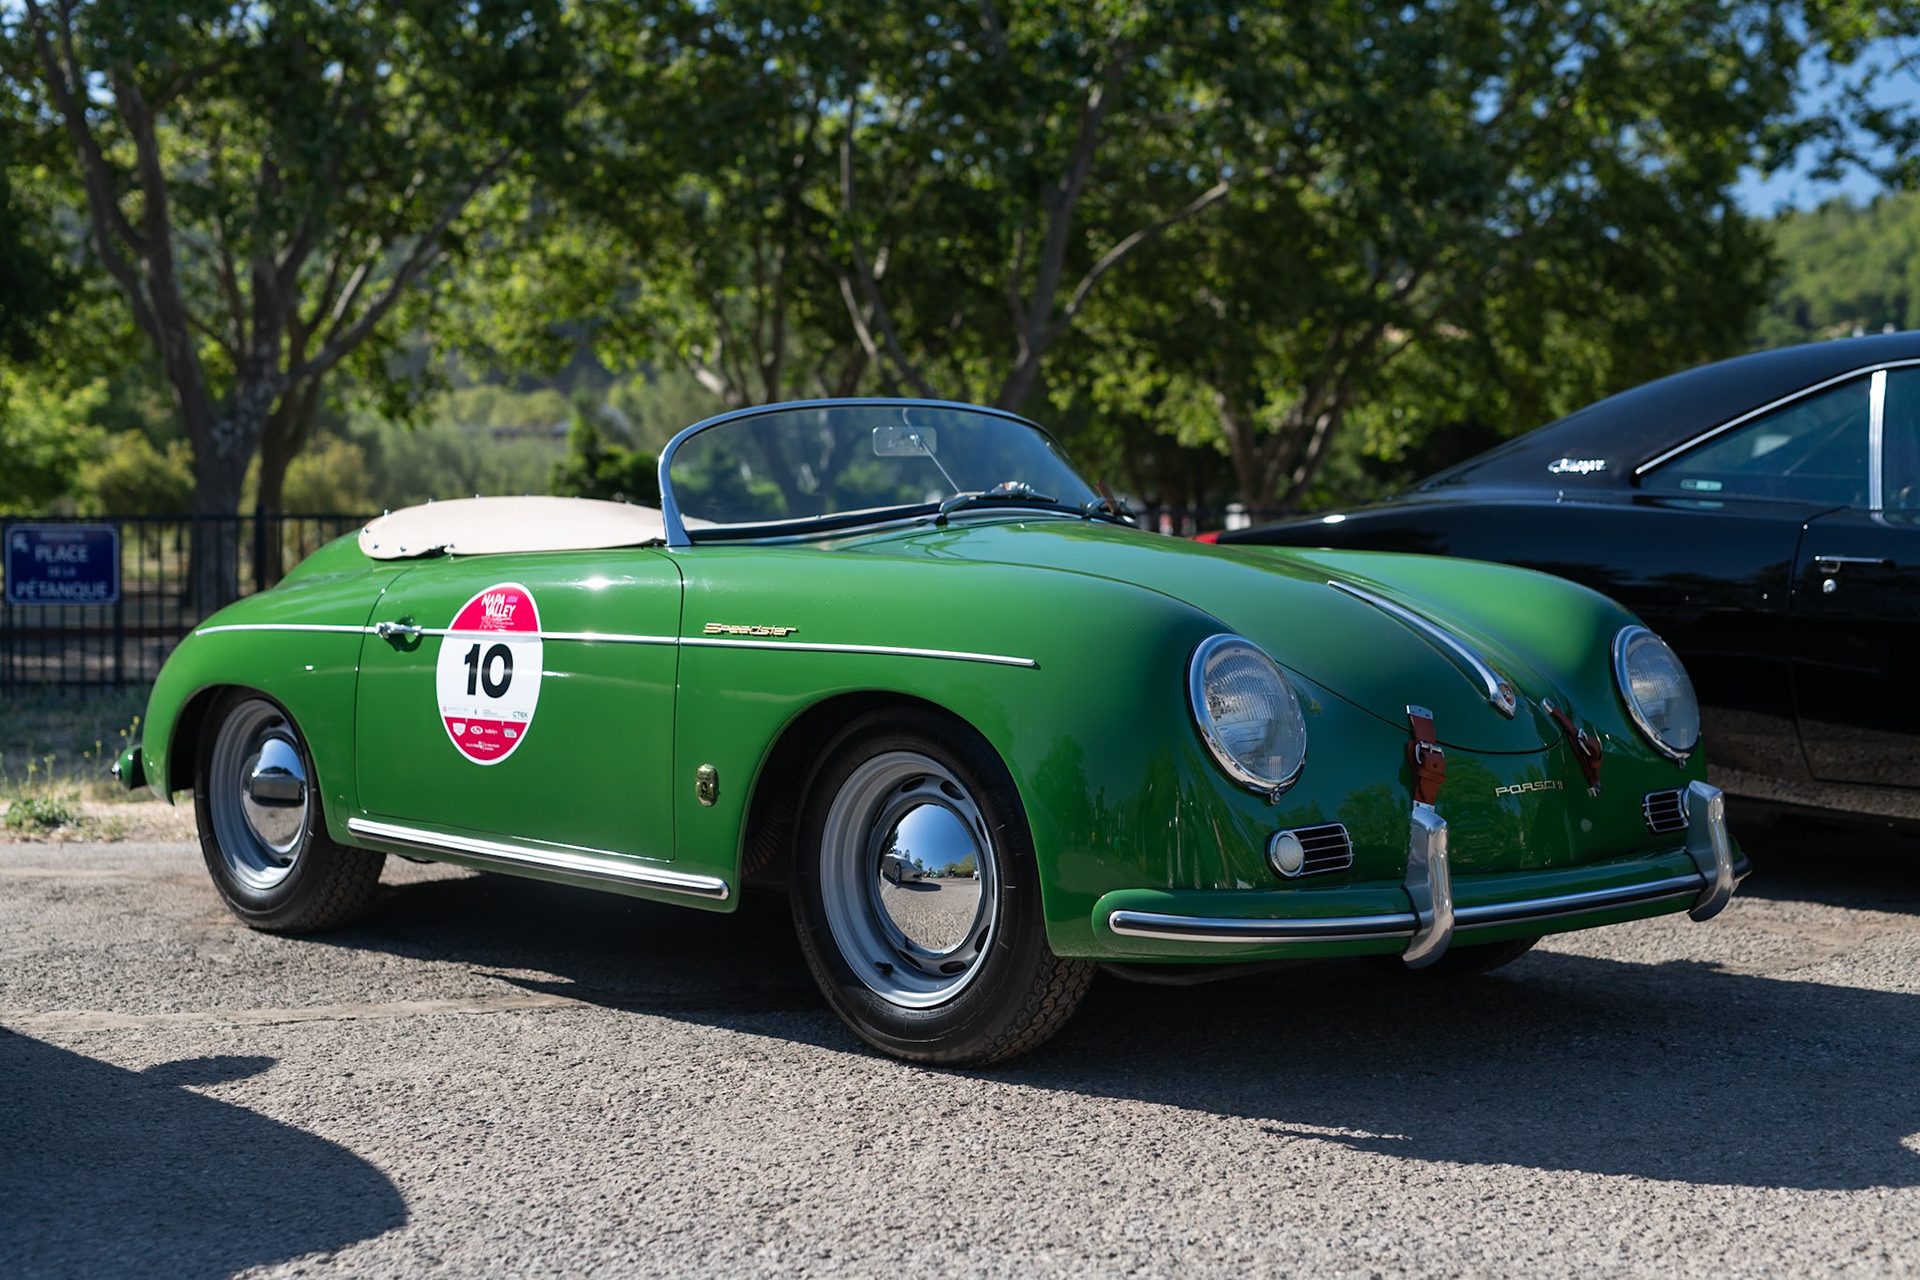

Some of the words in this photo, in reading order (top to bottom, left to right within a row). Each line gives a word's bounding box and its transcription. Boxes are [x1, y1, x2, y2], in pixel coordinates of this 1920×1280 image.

[35, 544, 89, 562] PLACE
[481, 594, 505, 606] NAPA
[485, 604, 516, 617] VALLEY
[703, 622, 796, 636] Speedster
[464, 643, 513, 698] 10
[1495, 780, 1564, 797] PORSCH
